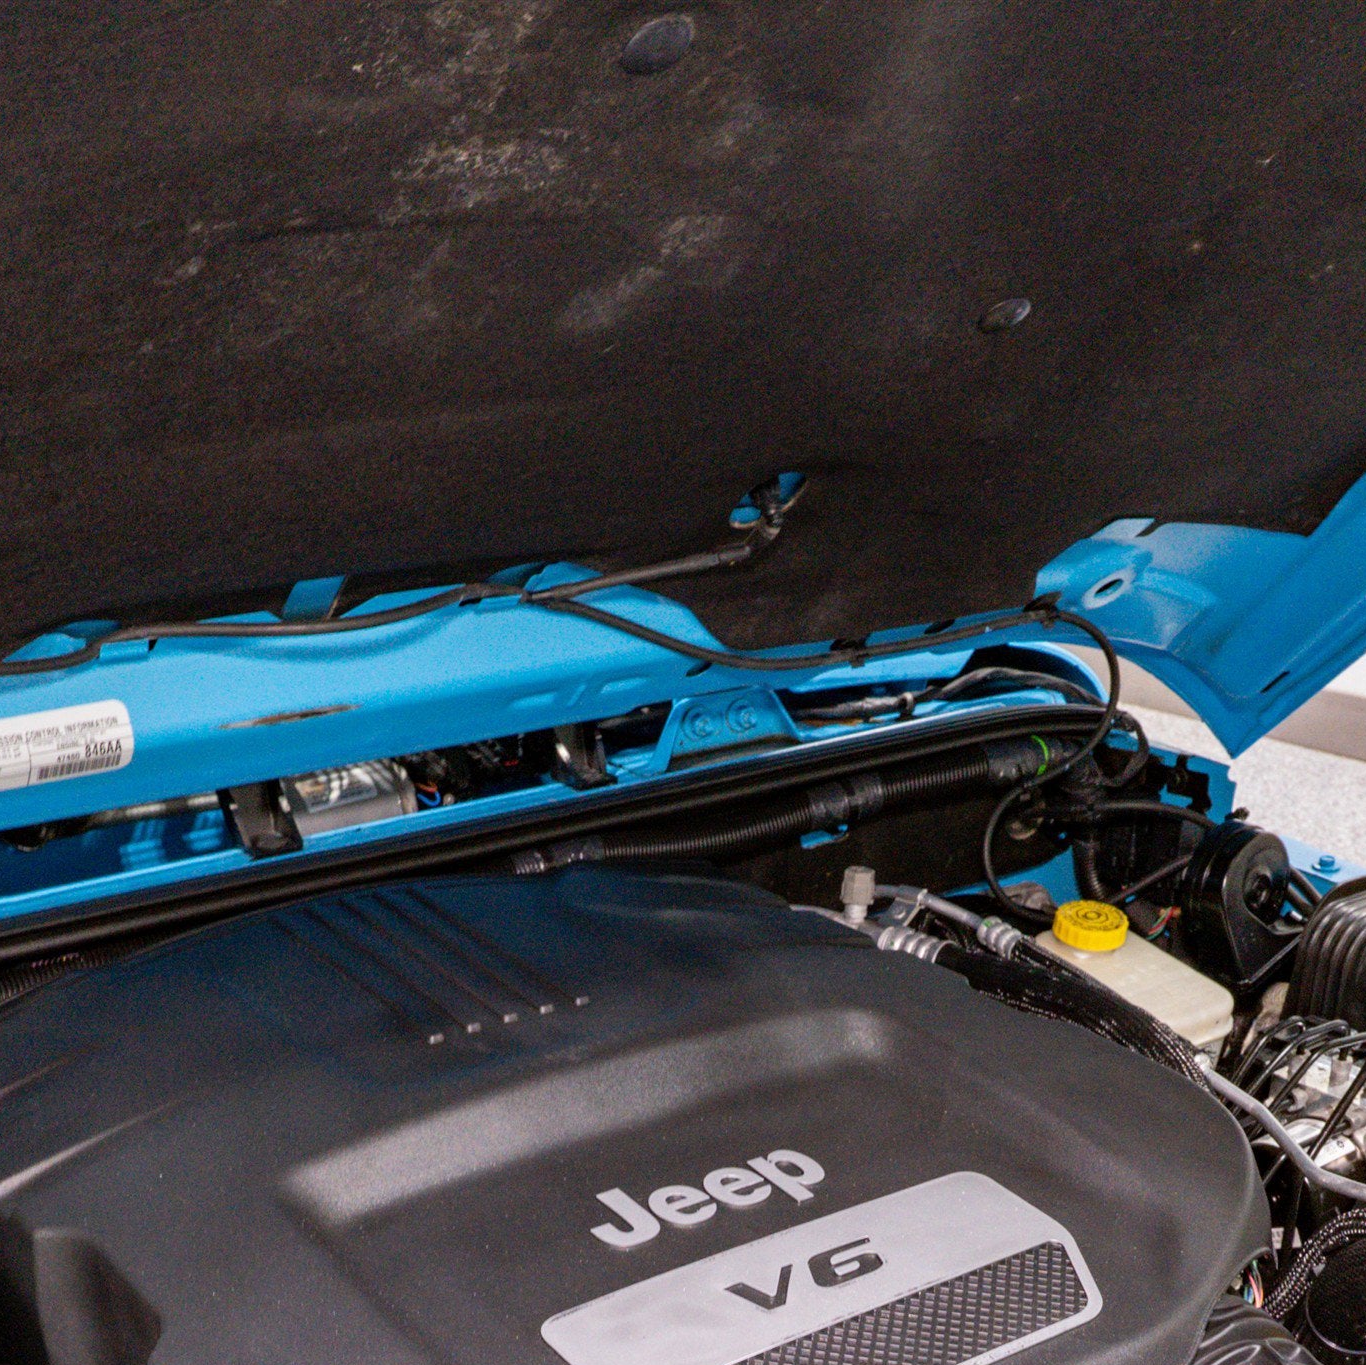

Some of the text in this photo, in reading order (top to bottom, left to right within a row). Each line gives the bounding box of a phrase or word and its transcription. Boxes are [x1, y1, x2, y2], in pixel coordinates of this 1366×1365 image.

[26, 726, 60, 740] CONTROL
[64, 716, 118, 732] INFORMATION
[85, 739, 122, 757] 846AA
[590, 1149, 825, 1248] Jeep
[725, 1236, 885, 1311] V6
